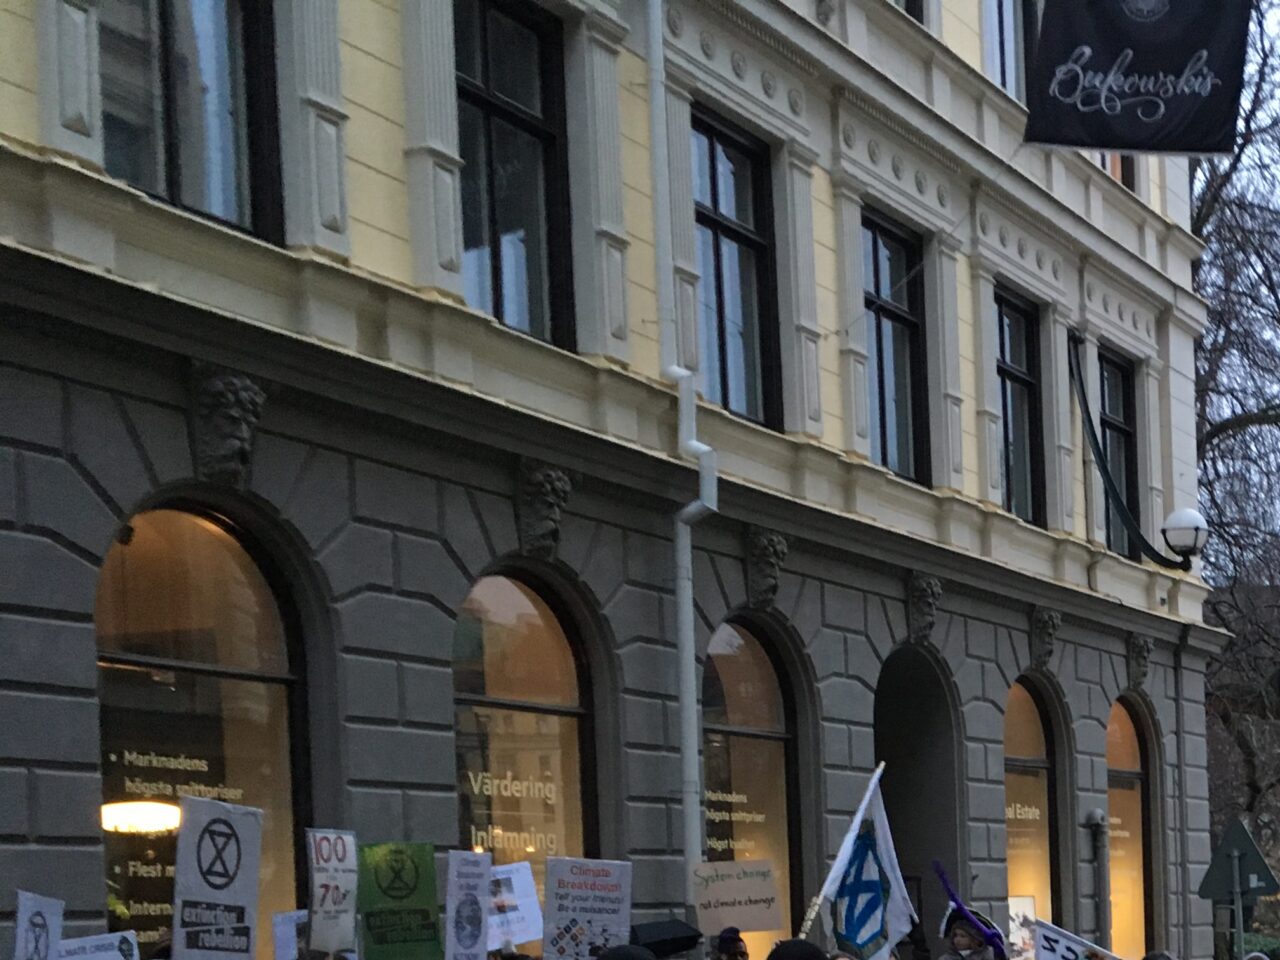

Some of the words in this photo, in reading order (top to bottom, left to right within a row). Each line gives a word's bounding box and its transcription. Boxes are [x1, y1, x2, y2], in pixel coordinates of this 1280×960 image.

[124, 750, 209, 772] Marknadens
[124, 776, 173, 797] högsta
[468, 770, 557, 804] Värdering
[1016, 803, 1040, 820] Estate
[312, 833, 347, 865] 100
[470, 824, 557, 854] Inlämning
[128, 861, 162, 877] Flest
[570, 864, 612, 878] Climate
[130, 900, 175, 916] Intern
[183, 903, 238, 924] extinction
[200, 927, 248, 950] rebellion
